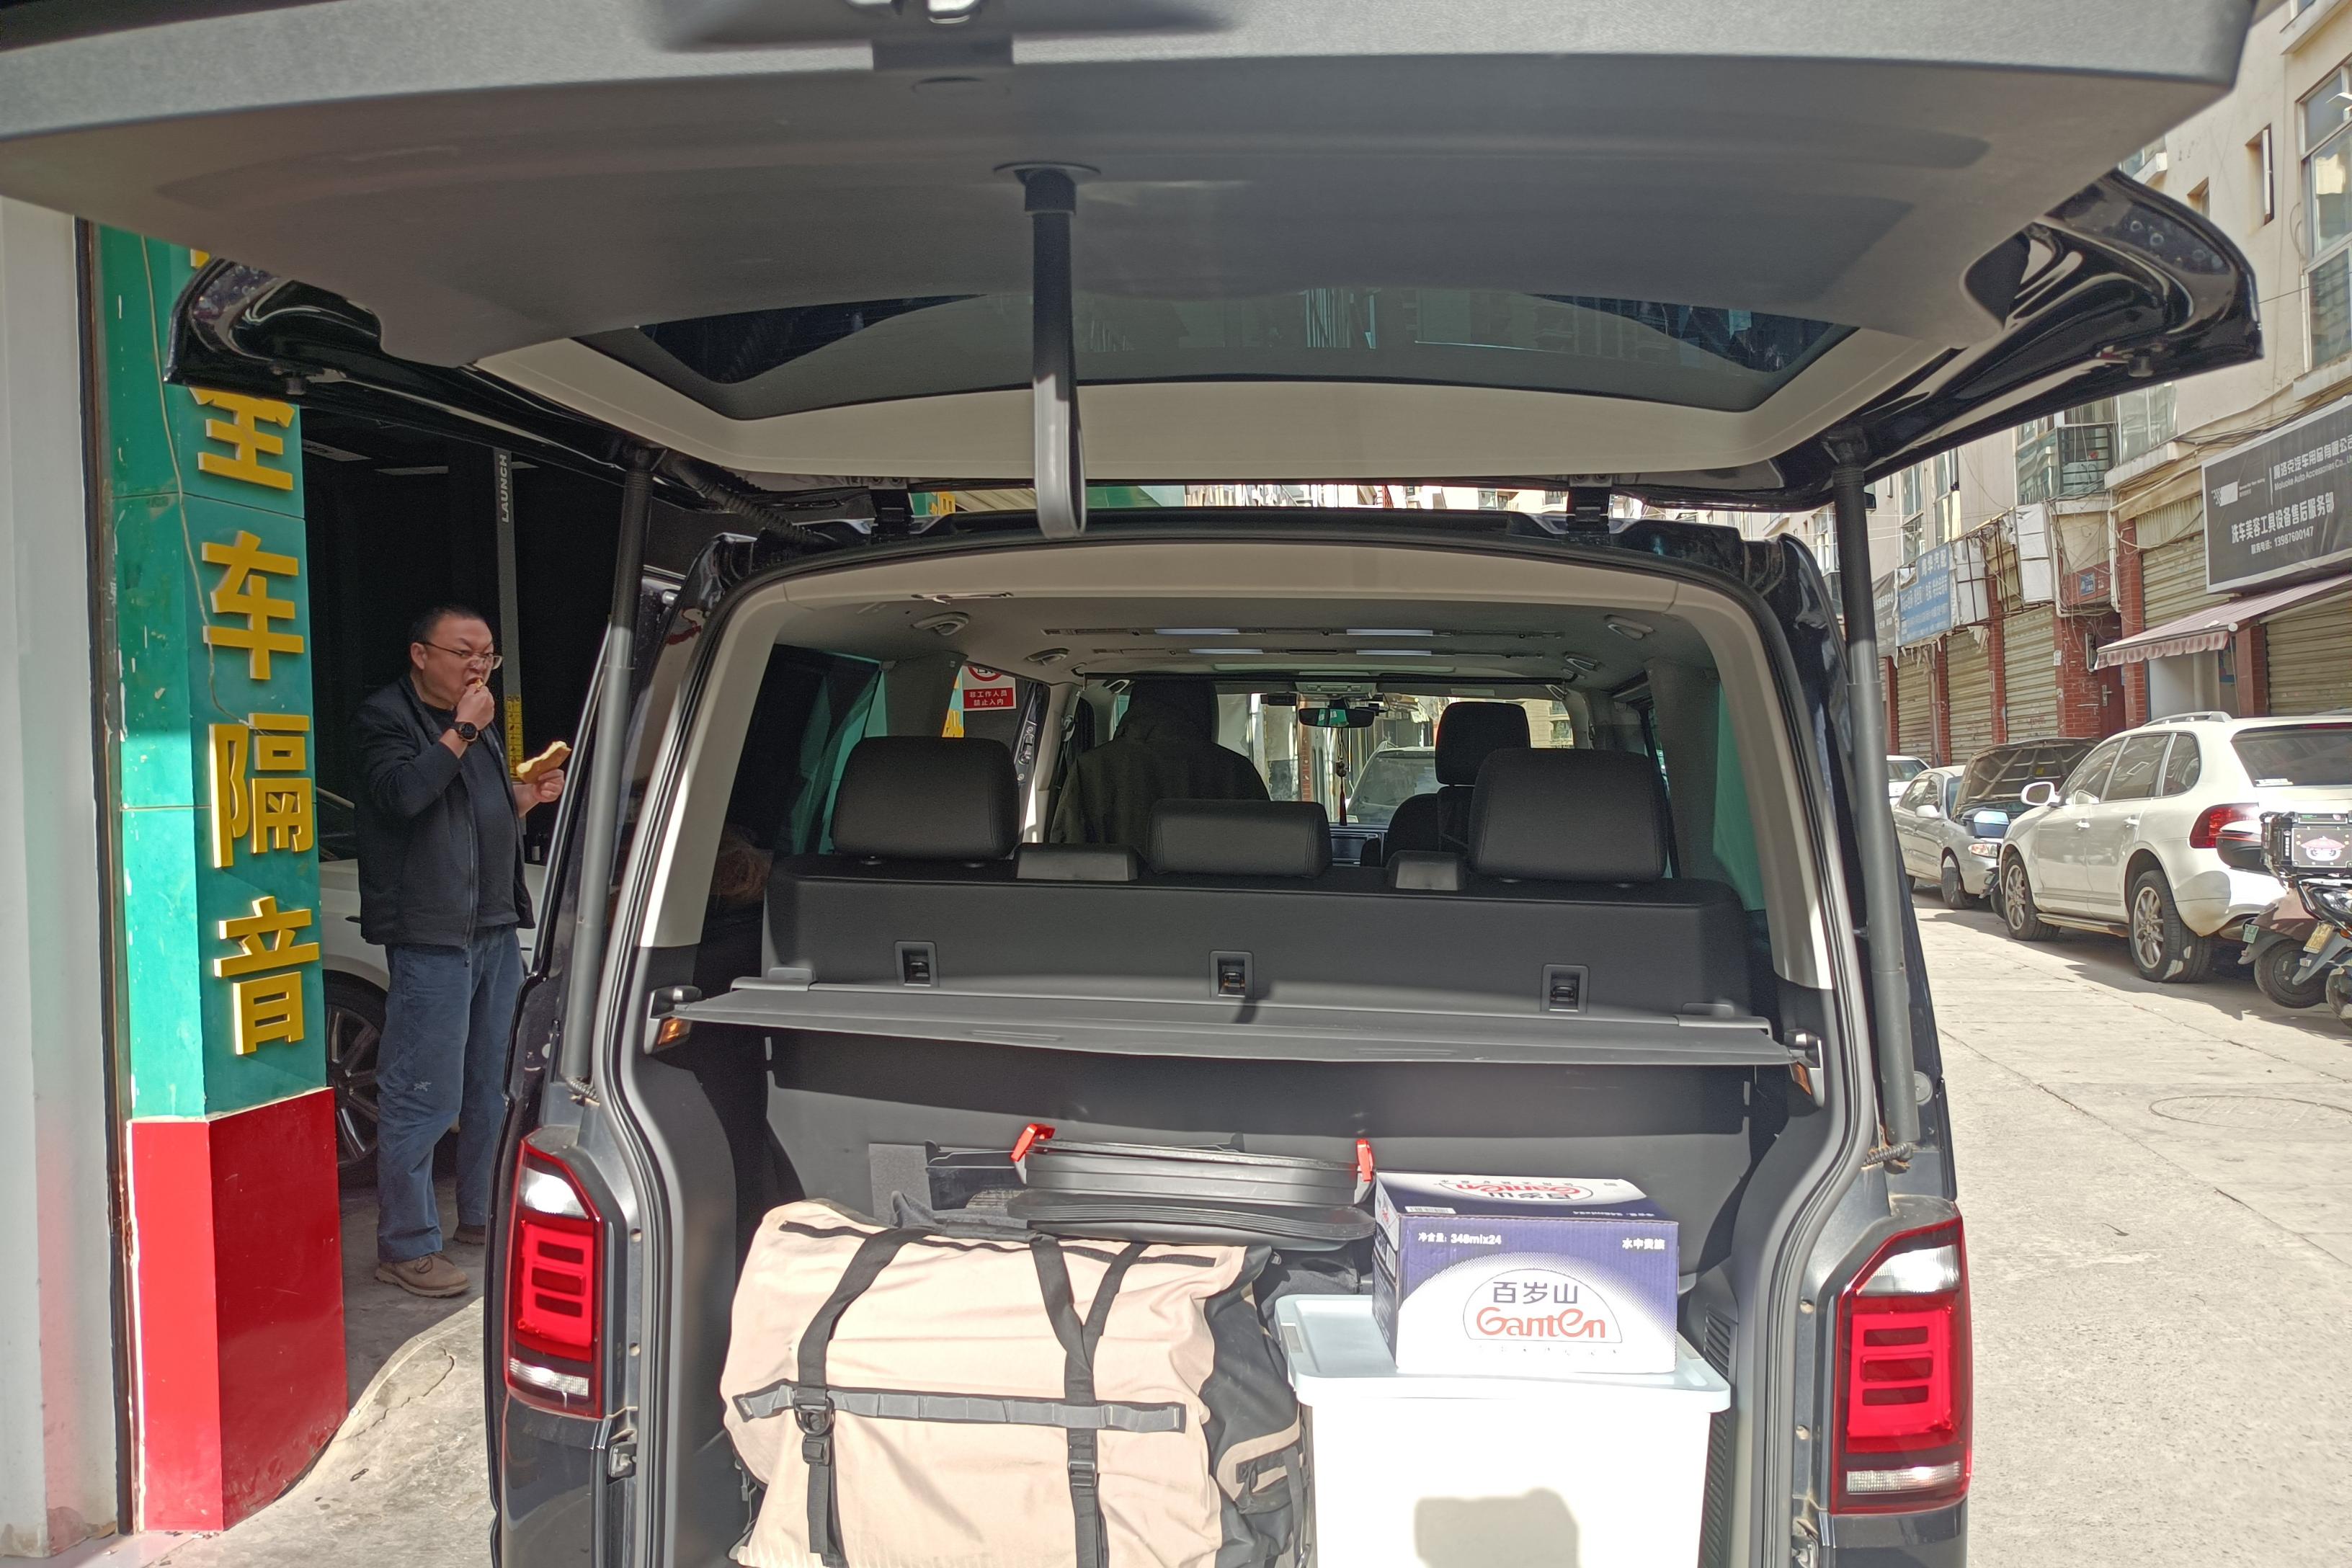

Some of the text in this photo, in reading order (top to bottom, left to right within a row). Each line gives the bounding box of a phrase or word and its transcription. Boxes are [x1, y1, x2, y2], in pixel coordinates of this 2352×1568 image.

[500, 454, 510, 524] LAUNCH
[2294, 473, 2305, 484] Auto
[2231, 491, 2335, 544] 洗车美容工具设备售后服务部
[2274, 525, 2315, 548] 13987600147
[969, 690, 1008, 698] 非工作人员
[1492, 1281, 1578, 1304] 百岁山
